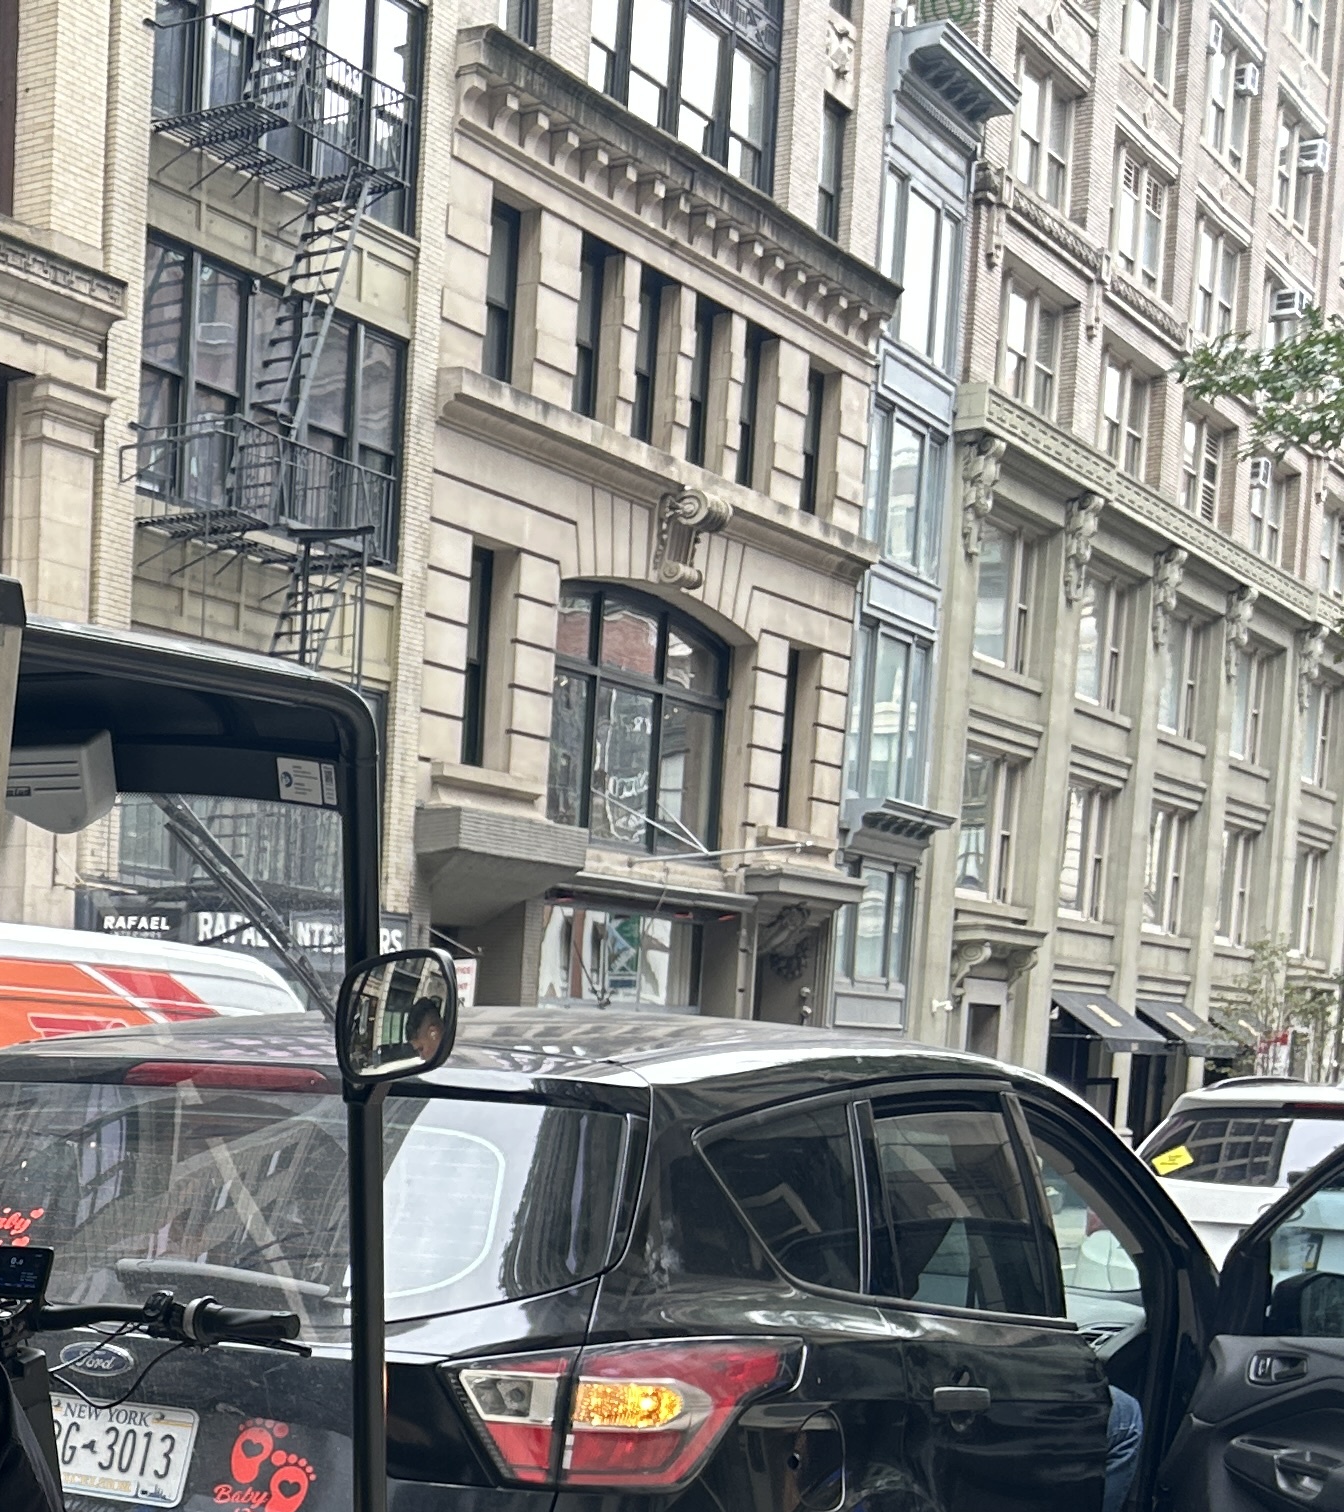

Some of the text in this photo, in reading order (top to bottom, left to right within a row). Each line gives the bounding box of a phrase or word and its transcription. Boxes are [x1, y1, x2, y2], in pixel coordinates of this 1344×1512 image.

[103, 915, 170, 930] RAFAEL
[64, 1402, 152, 1428] NEW YORK
[213, 1484, 269, 1510] Baby
